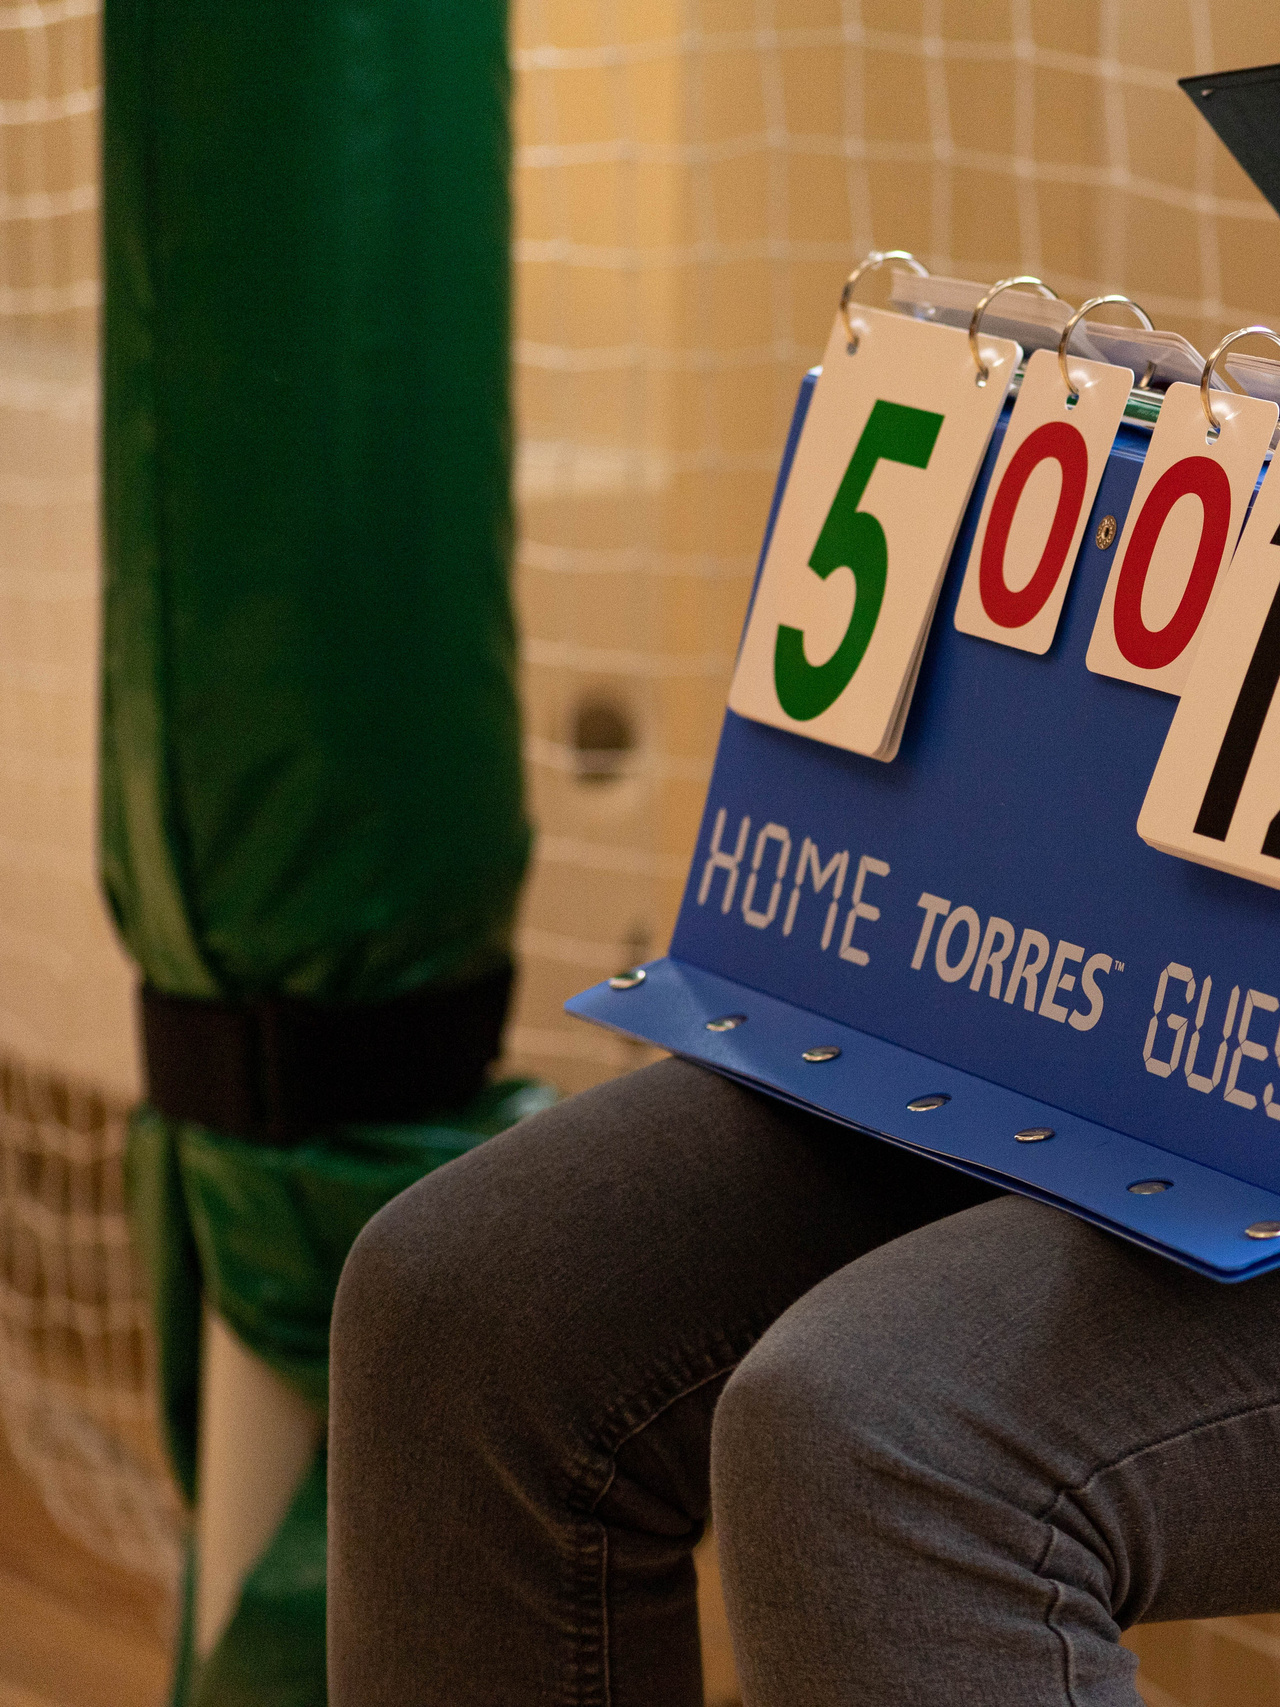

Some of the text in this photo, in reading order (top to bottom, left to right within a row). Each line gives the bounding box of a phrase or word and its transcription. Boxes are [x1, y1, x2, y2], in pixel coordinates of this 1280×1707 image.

[773, 399, 945, 722] 5
[979, 421, 1088, 629] 0
[1113, 456, 1231, 670] 0
[698, 808, 891, 966] HOME
